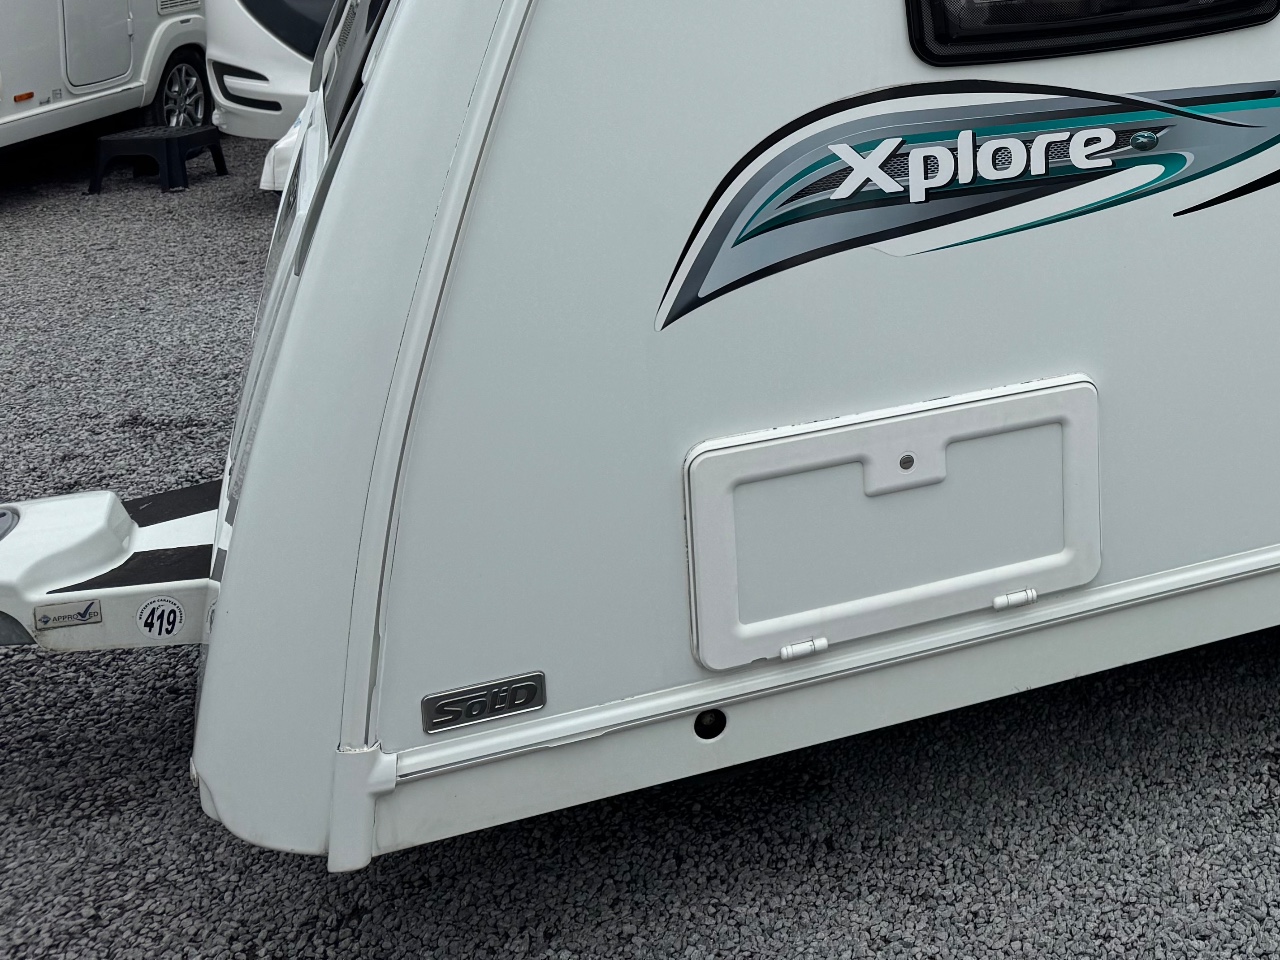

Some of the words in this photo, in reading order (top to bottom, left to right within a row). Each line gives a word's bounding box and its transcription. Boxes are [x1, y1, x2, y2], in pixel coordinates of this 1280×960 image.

[827, 128, 1116, 203] Xplore
[52, 602, 99, 622] APPROVED
[143, 606, 177, 636] 419
